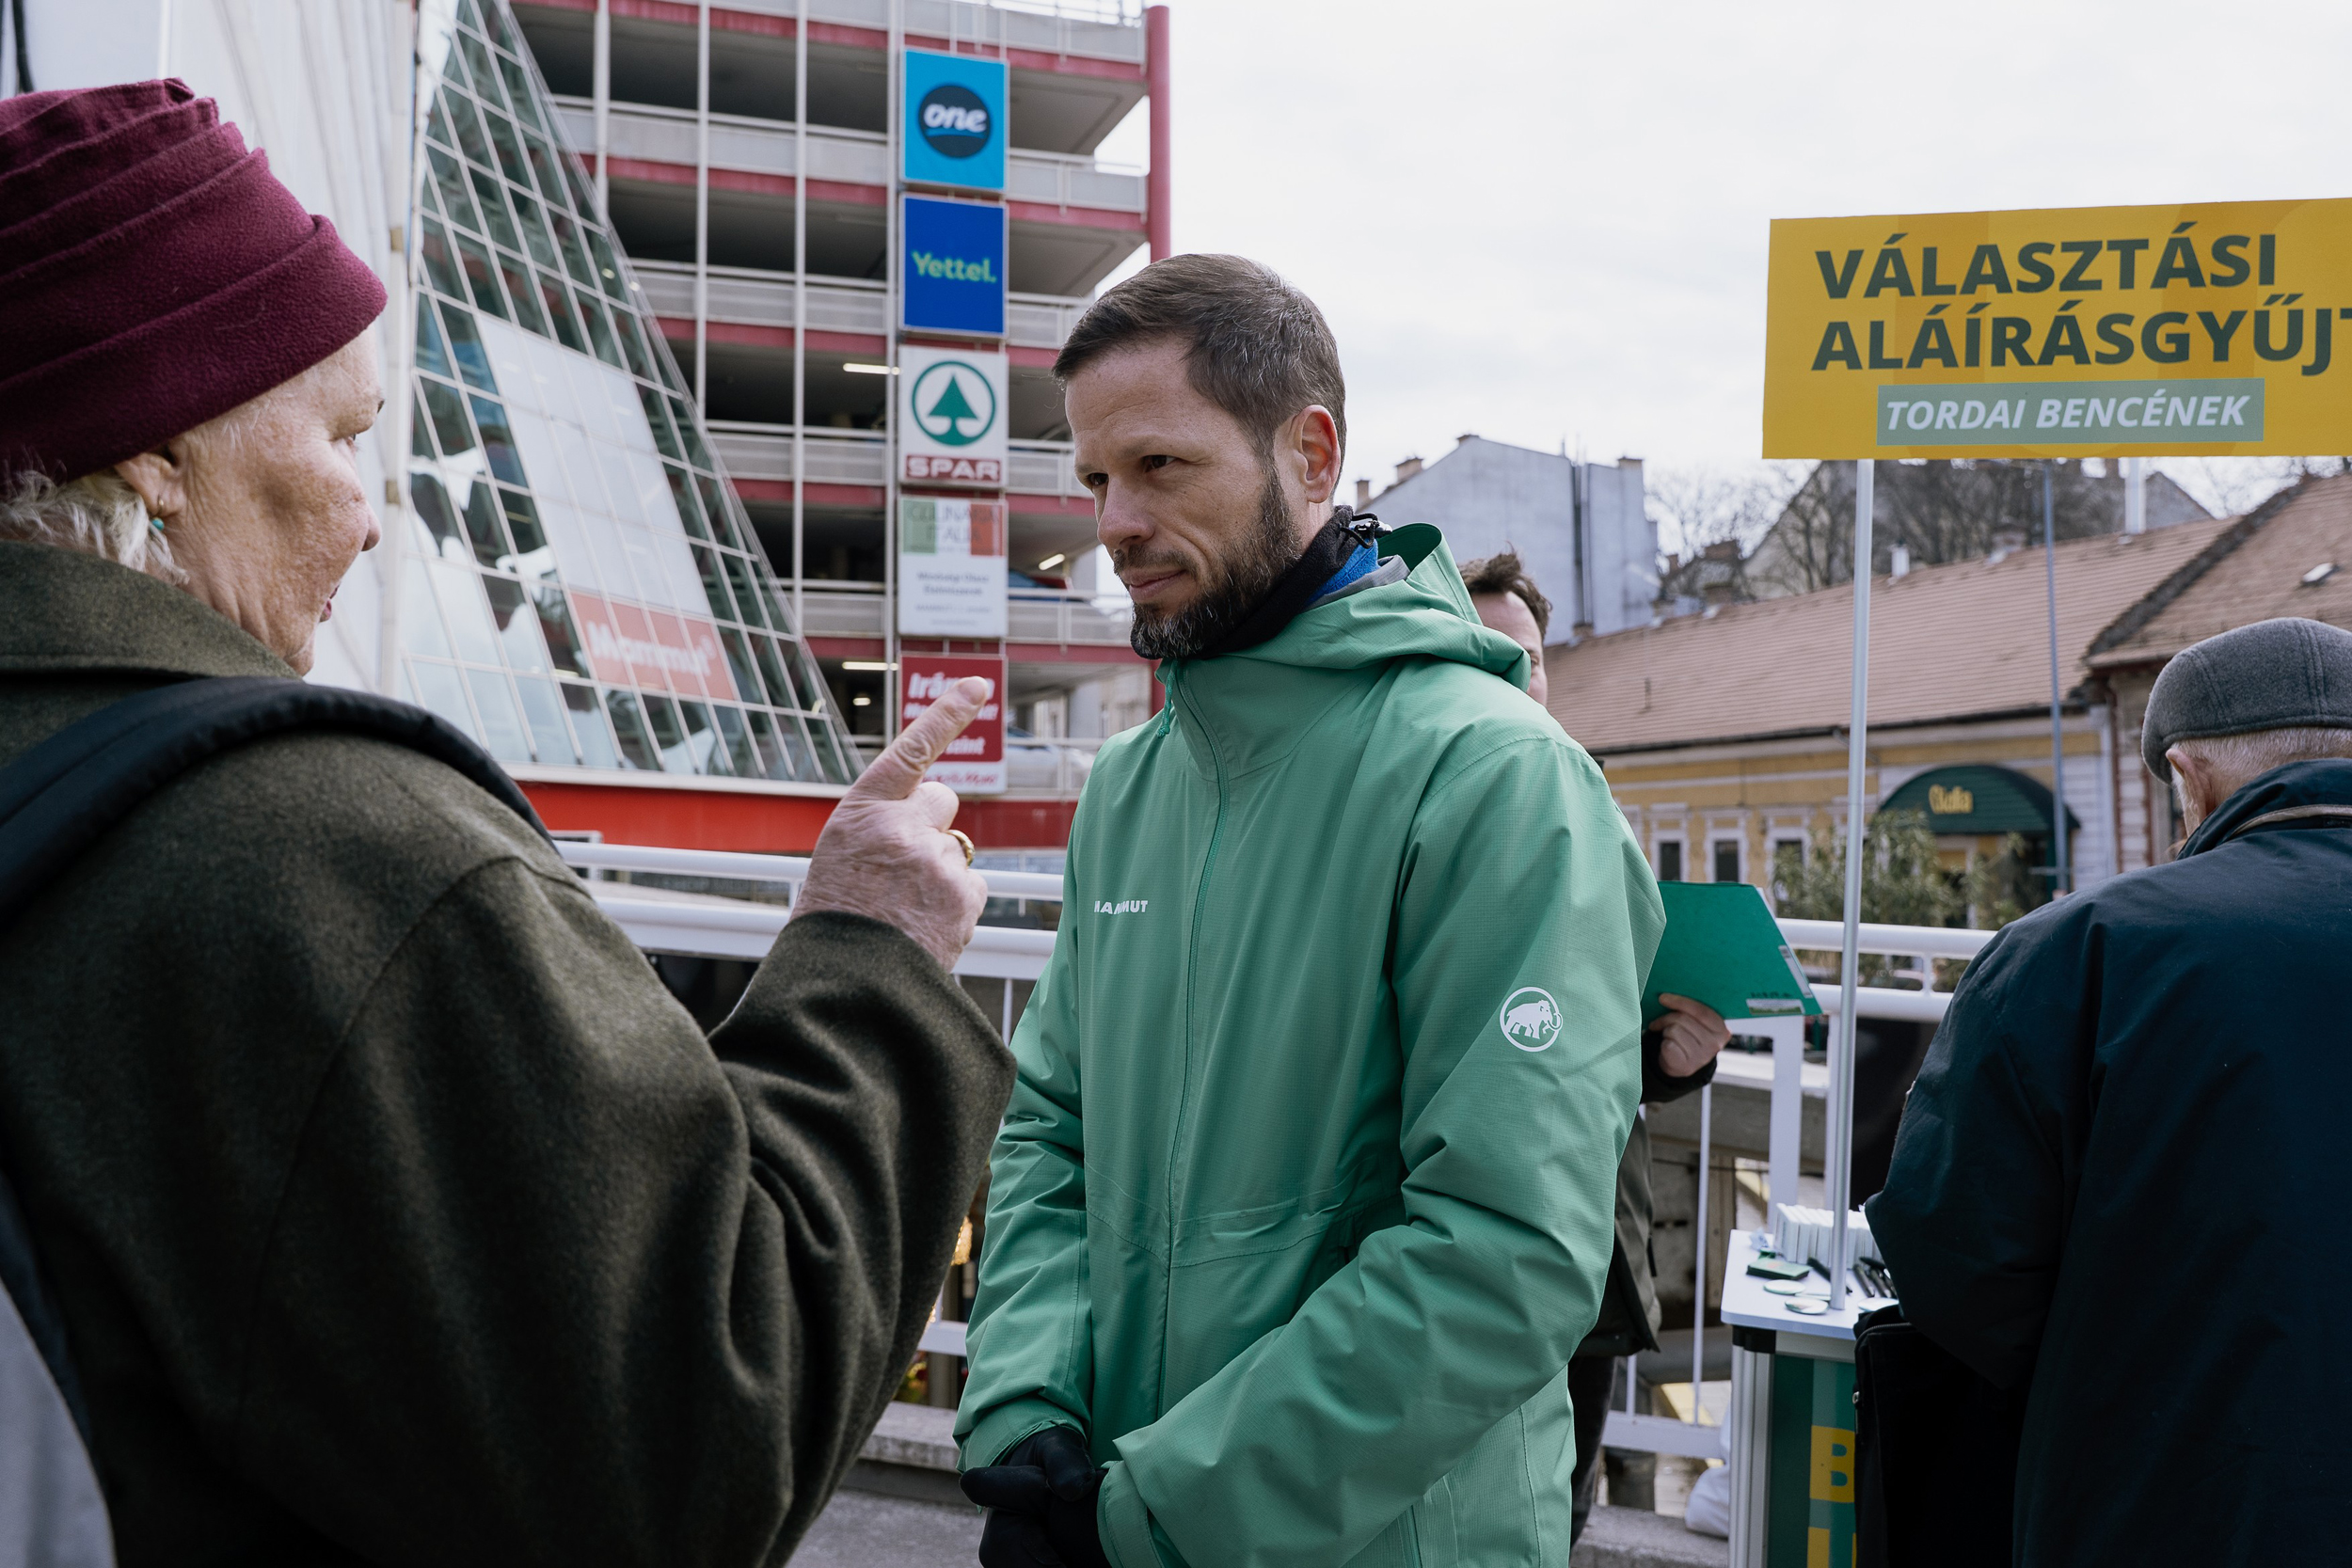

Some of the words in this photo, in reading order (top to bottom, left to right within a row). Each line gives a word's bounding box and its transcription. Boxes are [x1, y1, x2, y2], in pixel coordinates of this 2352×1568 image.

[923, 103, 988, 133] one
[911, 250, 996, 283] Yettel.
[1815, 221, 2276, 299] VÁLASZTÁSI
[1811, 293, 2352, 376] ALÁÍRÁSGYŰJ
[1887, 399, 2026, 430] TORDAI
[2036, 388, 2250, 428] BENCÉNEK
[907, 456, 999, 481] SPAR
